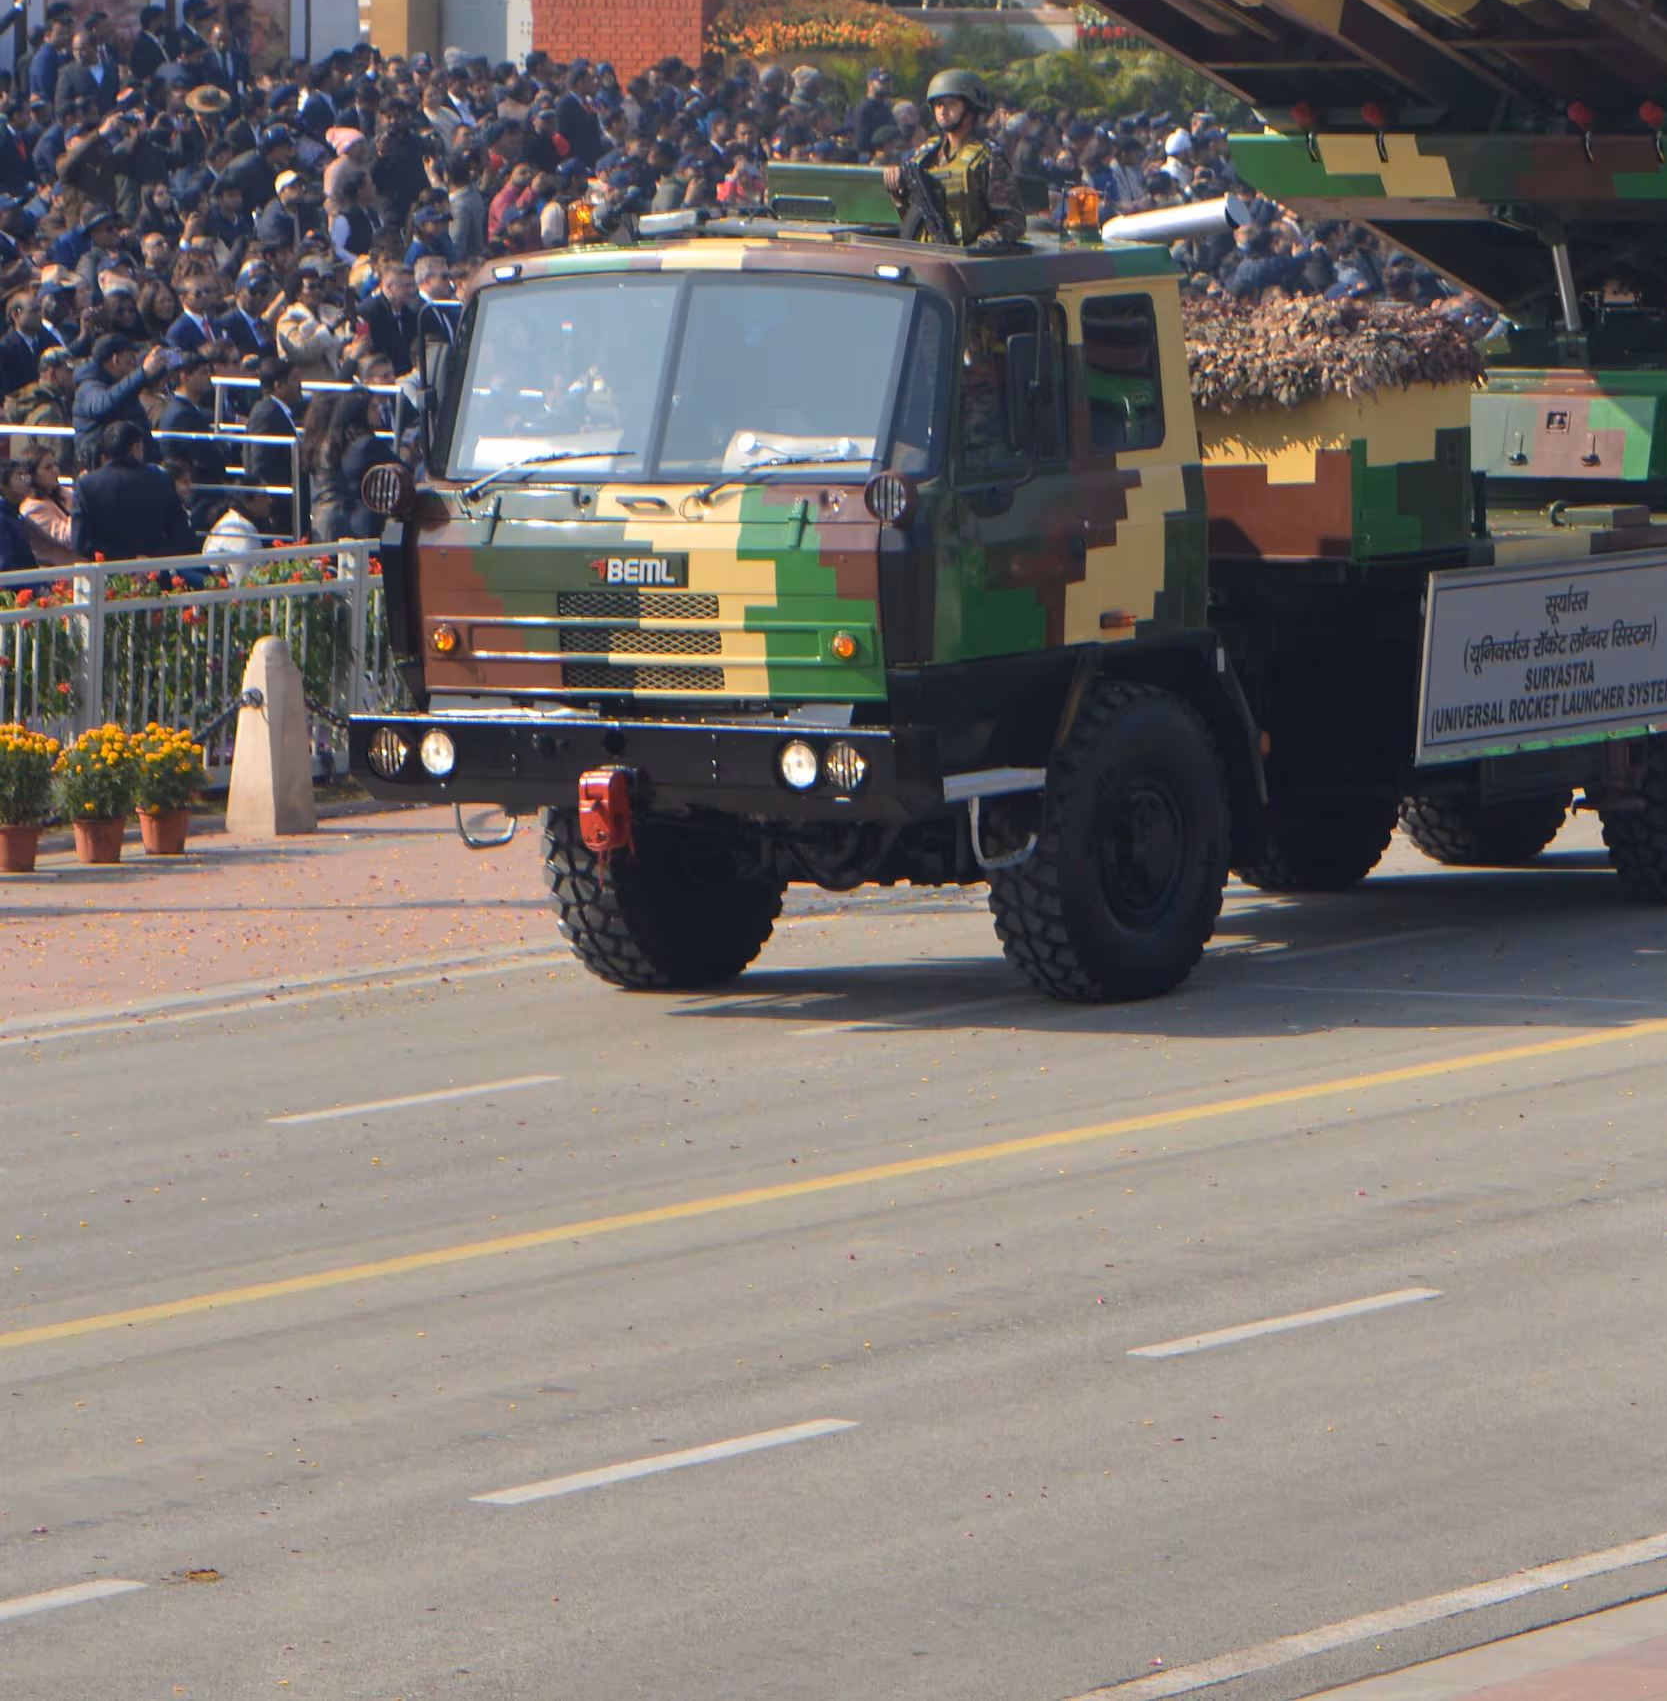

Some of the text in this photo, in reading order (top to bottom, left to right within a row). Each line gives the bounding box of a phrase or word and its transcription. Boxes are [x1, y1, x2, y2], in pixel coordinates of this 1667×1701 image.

[607, 557, 676, 586] BEML
[1524, 660, 1595, 692] SURYASTRA
[1431, 703, 1505, 740] (UNIVERSAL
[1509, 691, 1560, 723] ROCKET
[1561, 686, 1625, 716] LAUNCHER
